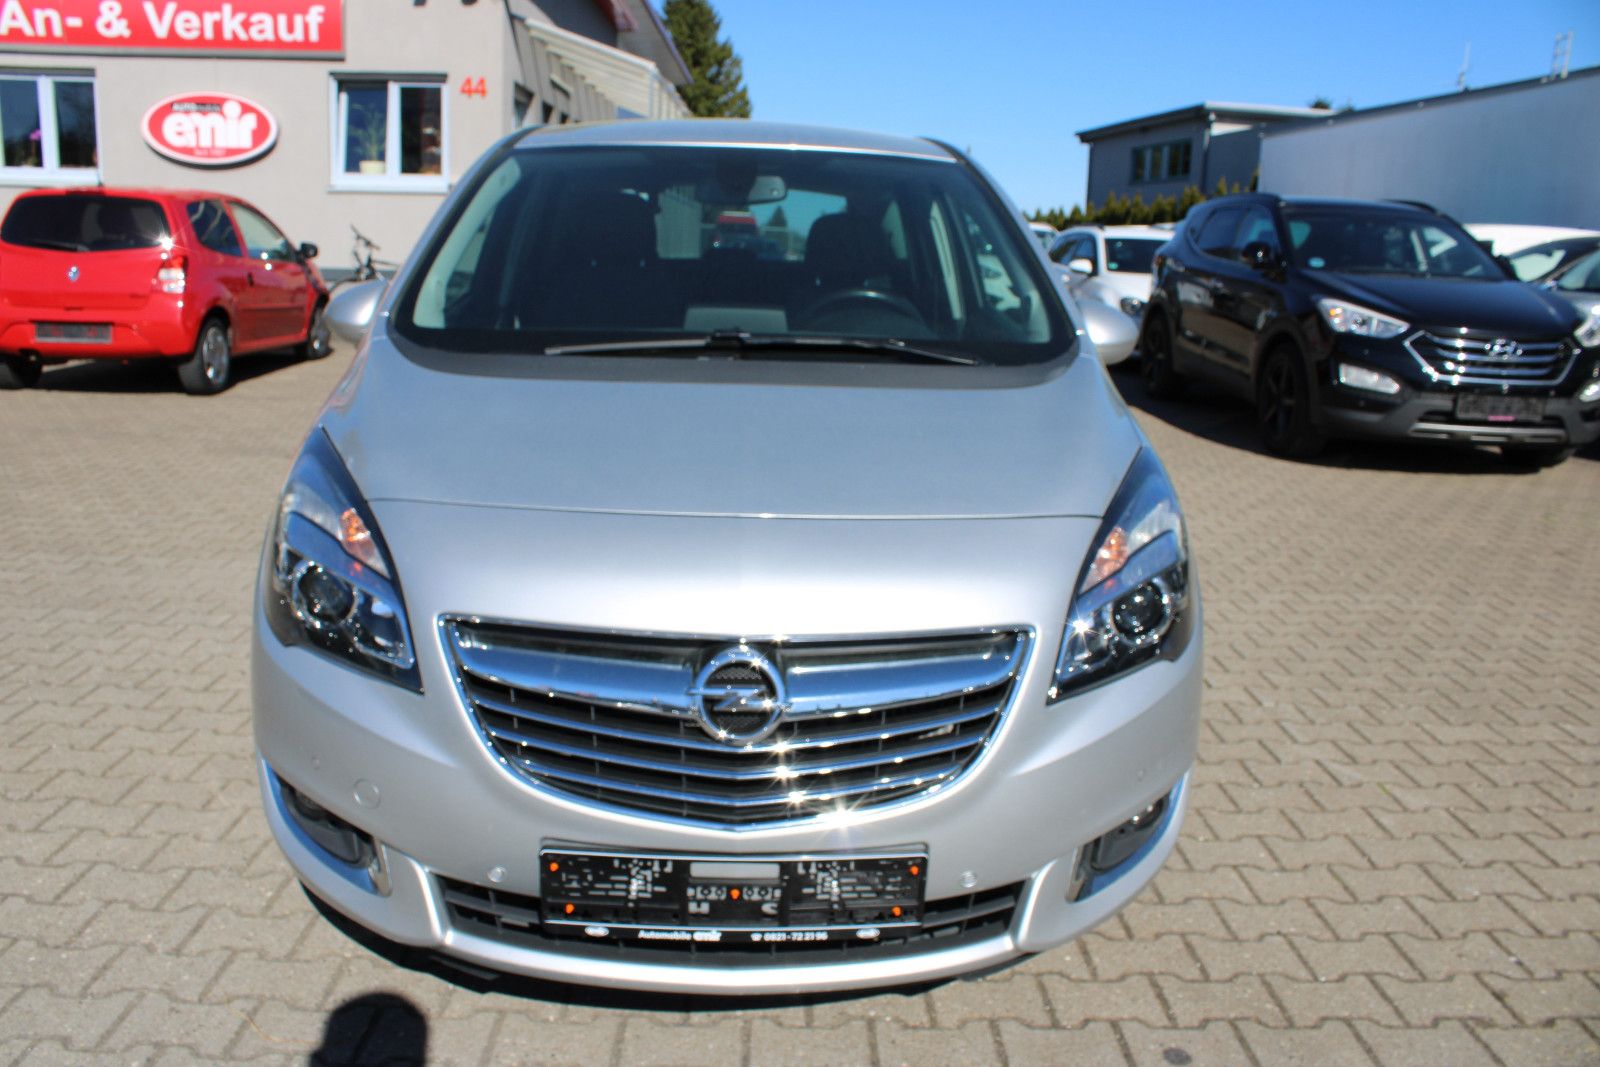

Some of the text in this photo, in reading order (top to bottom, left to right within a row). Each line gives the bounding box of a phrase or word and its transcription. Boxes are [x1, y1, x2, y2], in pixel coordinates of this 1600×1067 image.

[0, 0, 326, 42] An- & Verkauf
[459, 75, 488, 98] 44
[162, 99, 258, 148] emir
